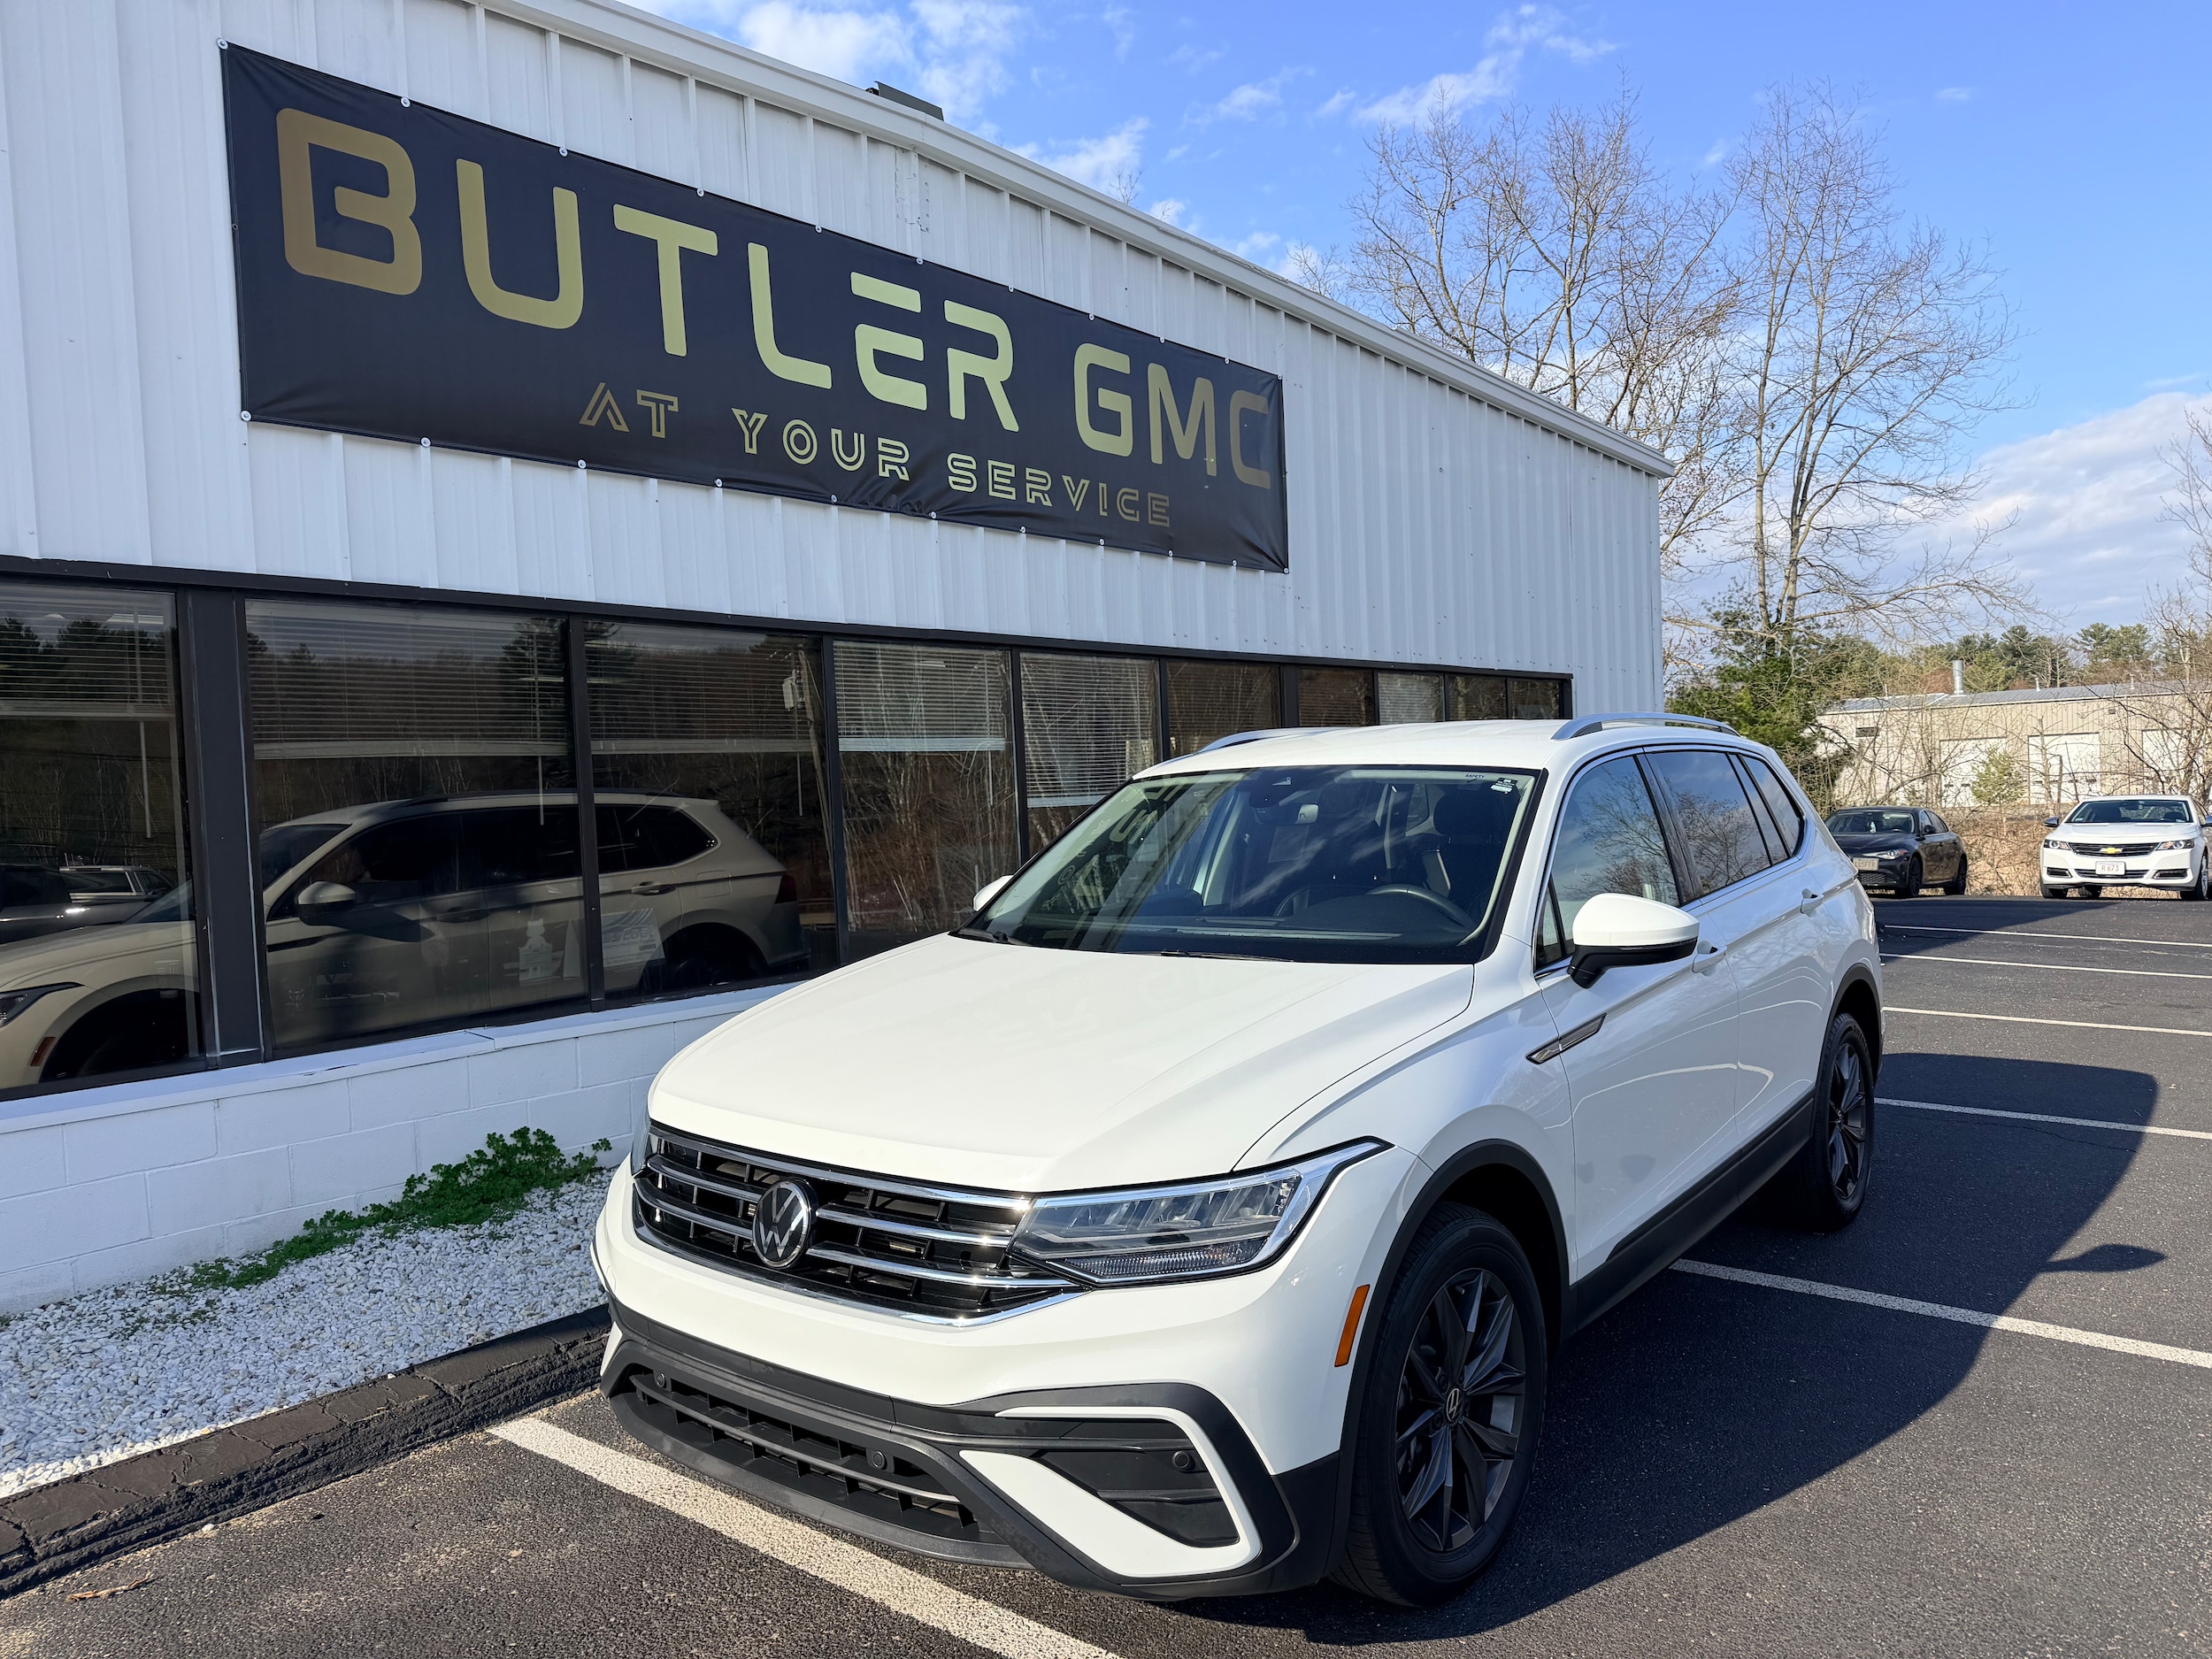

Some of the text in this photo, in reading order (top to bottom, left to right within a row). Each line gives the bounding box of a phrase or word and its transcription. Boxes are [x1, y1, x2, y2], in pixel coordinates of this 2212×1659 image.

[275, 107, 1271, 490] BUTLER GMC
[578, 381, 1171, 527] AT YOUR SERVICE
[757, 1183, 809, 1263] VW
